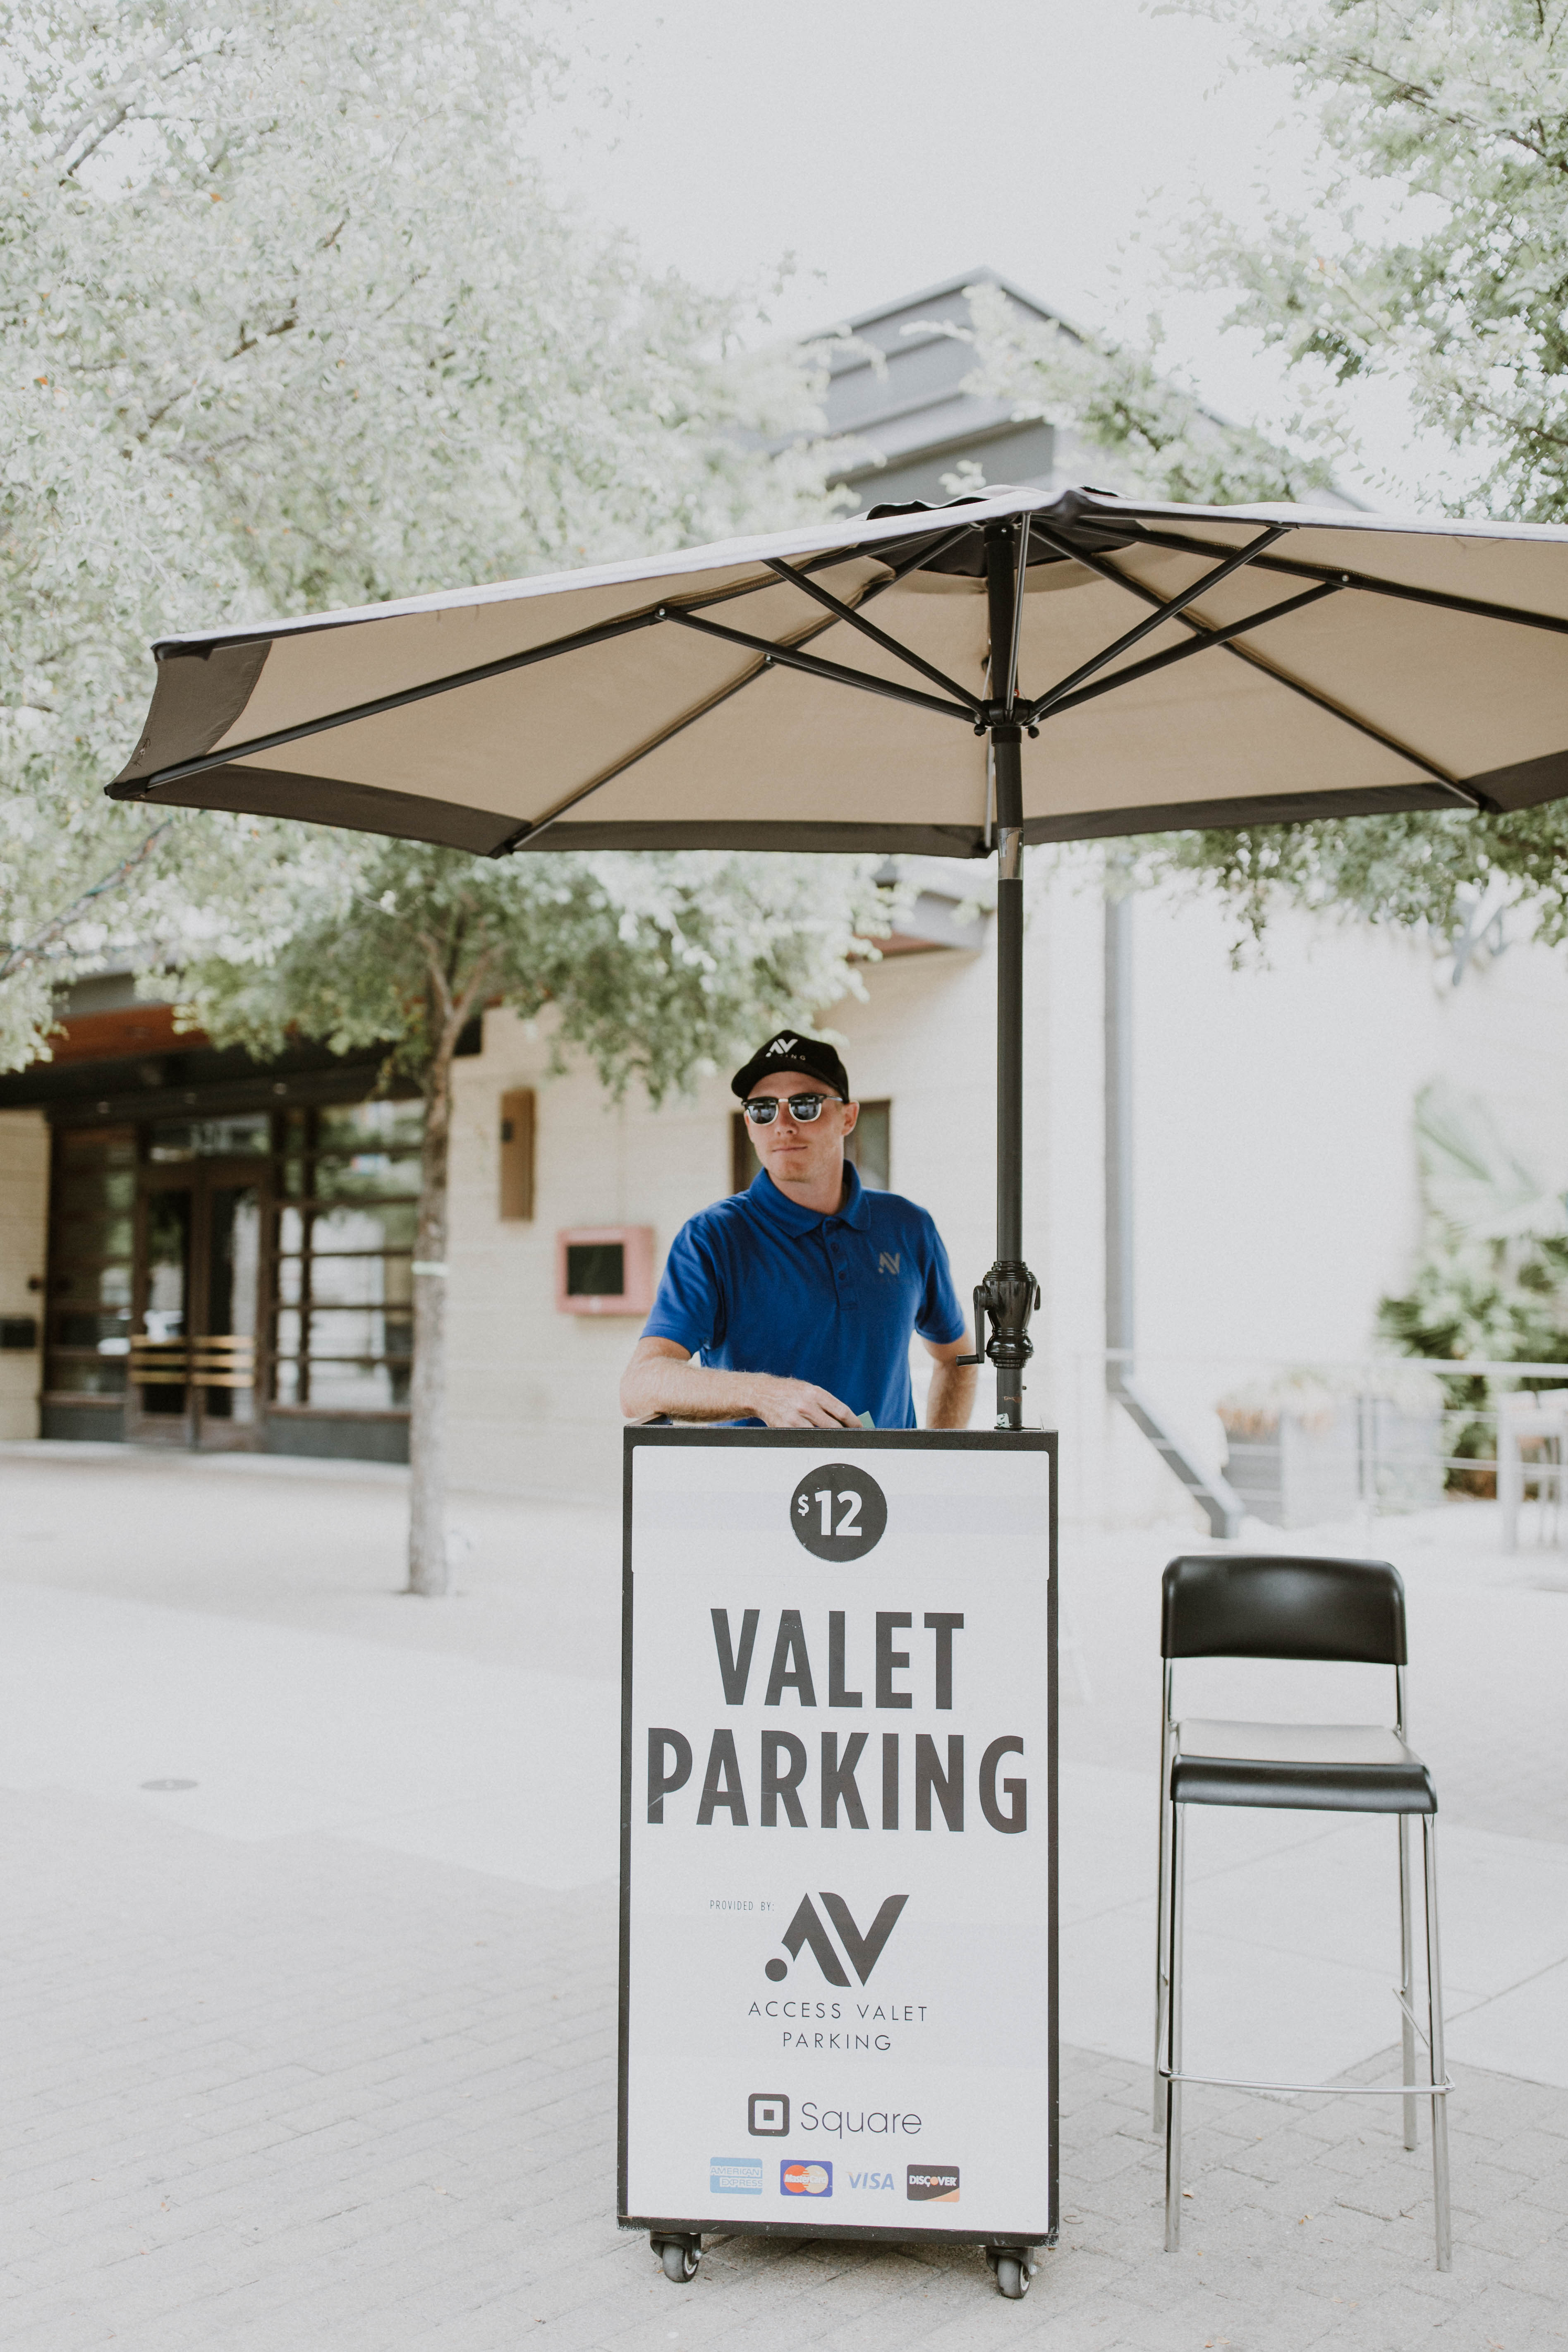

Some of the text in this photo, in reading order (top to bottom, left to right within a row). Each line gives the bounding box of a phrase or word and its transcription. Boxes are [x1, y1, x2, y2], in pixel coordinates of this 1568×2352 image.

[797, 1490, 862, 1536] $12
[710, 1608, 964, 1710] VALET
[647, 1727, 1027, 1834] PARKING
[710, 1899, 775, 1911] PROVIDED BY:
[748, 2001, 927, 2021] ACCESS VALET
[783, 2032, 891, 2050] PARKING
[801, 2102, 922, 2139] Square
[710, 2167, 759, 2176] AMERICAN
[784, 2174, 828, 2183] MasterCard
[845, 2171, 895, 2190] VISA
[721, 2178, 763, 2187] EXPRESS
[909, 2175, 957, 2187] DISCOVER
